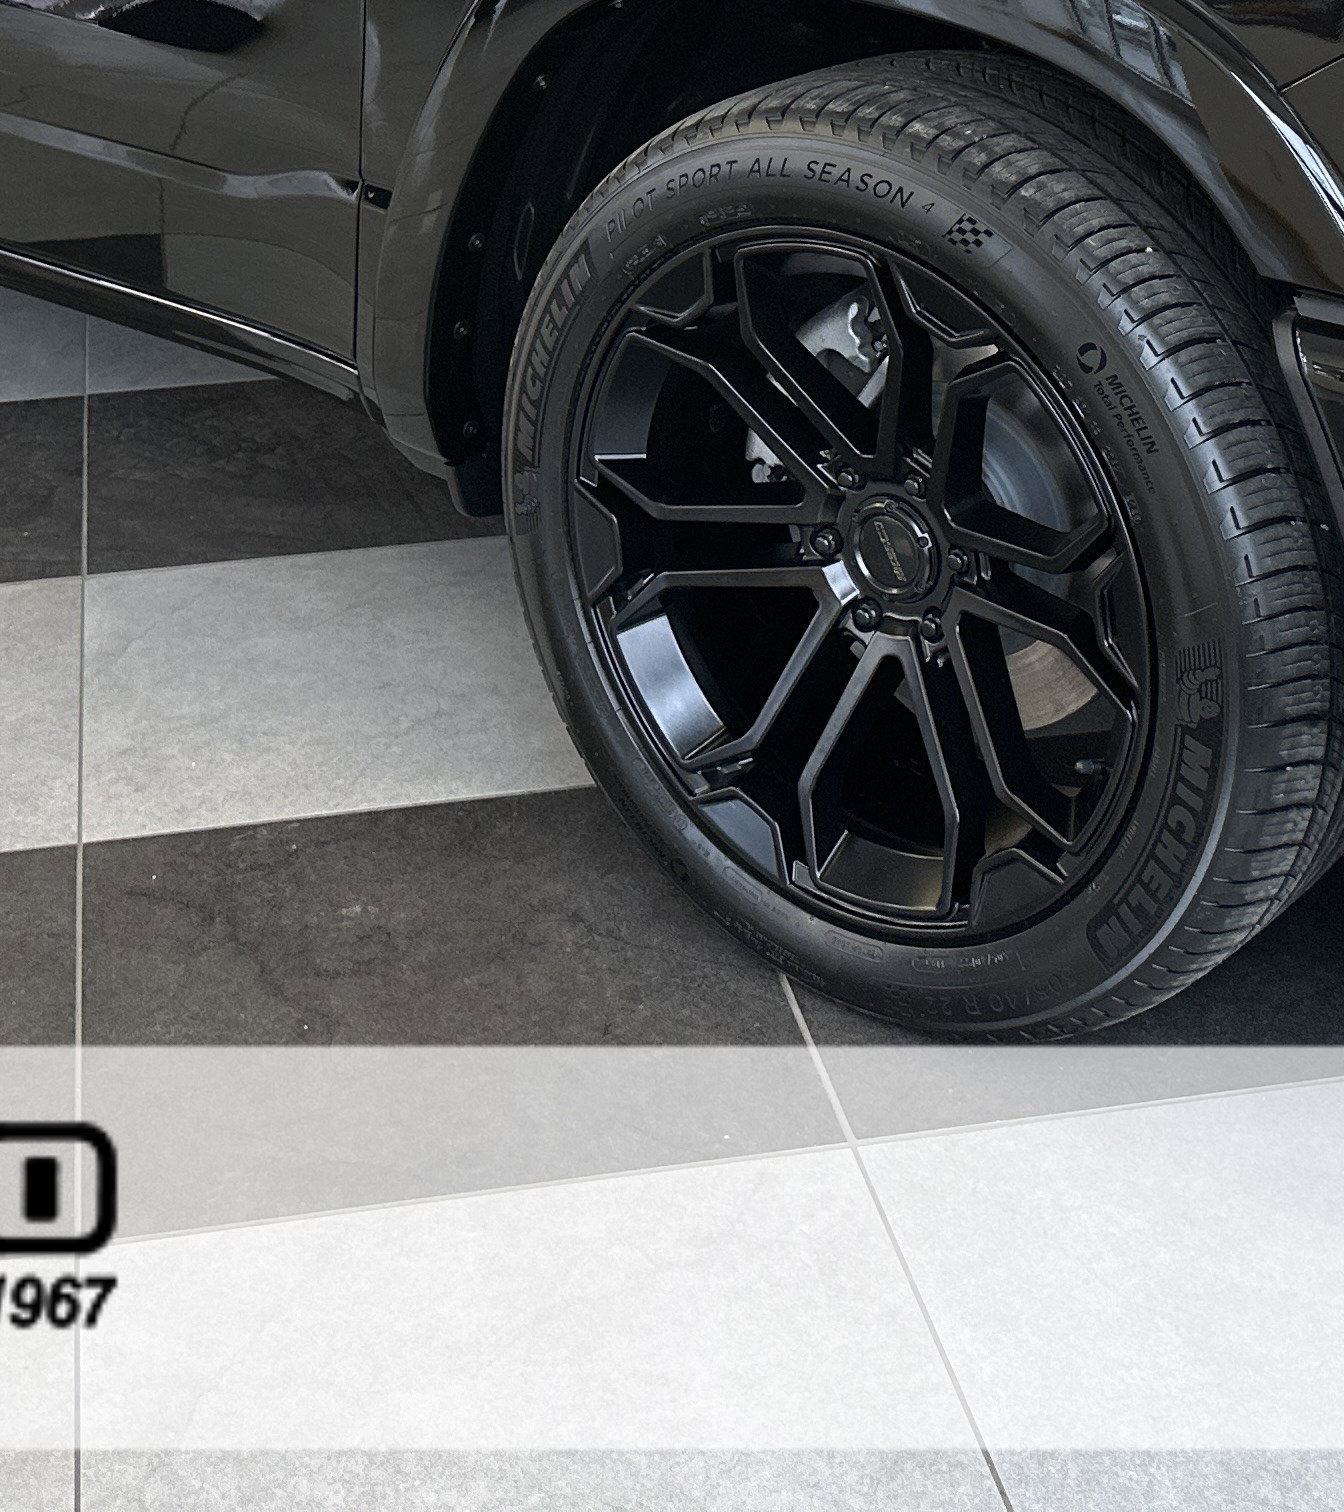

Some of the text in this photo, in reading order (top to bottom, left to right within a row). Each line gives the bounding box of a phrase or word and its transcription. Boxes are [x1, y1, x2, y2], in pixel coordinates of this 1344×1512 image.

[606, 188, 656, 243] PILOT
[665, 159, 739, 199] SPORT
[746, 157, 792, 179] ALL
[803, 160, 915, 209] SEASON
[921, 202, 936, 215] 4
[515, 253, 592, 460] MICHELIN
[1105, 373, 1160, 455] MICHELIN
[1094, 380, 1156, 495] Total Performance
[1094, 734, 1214, 964] MICHELIN
